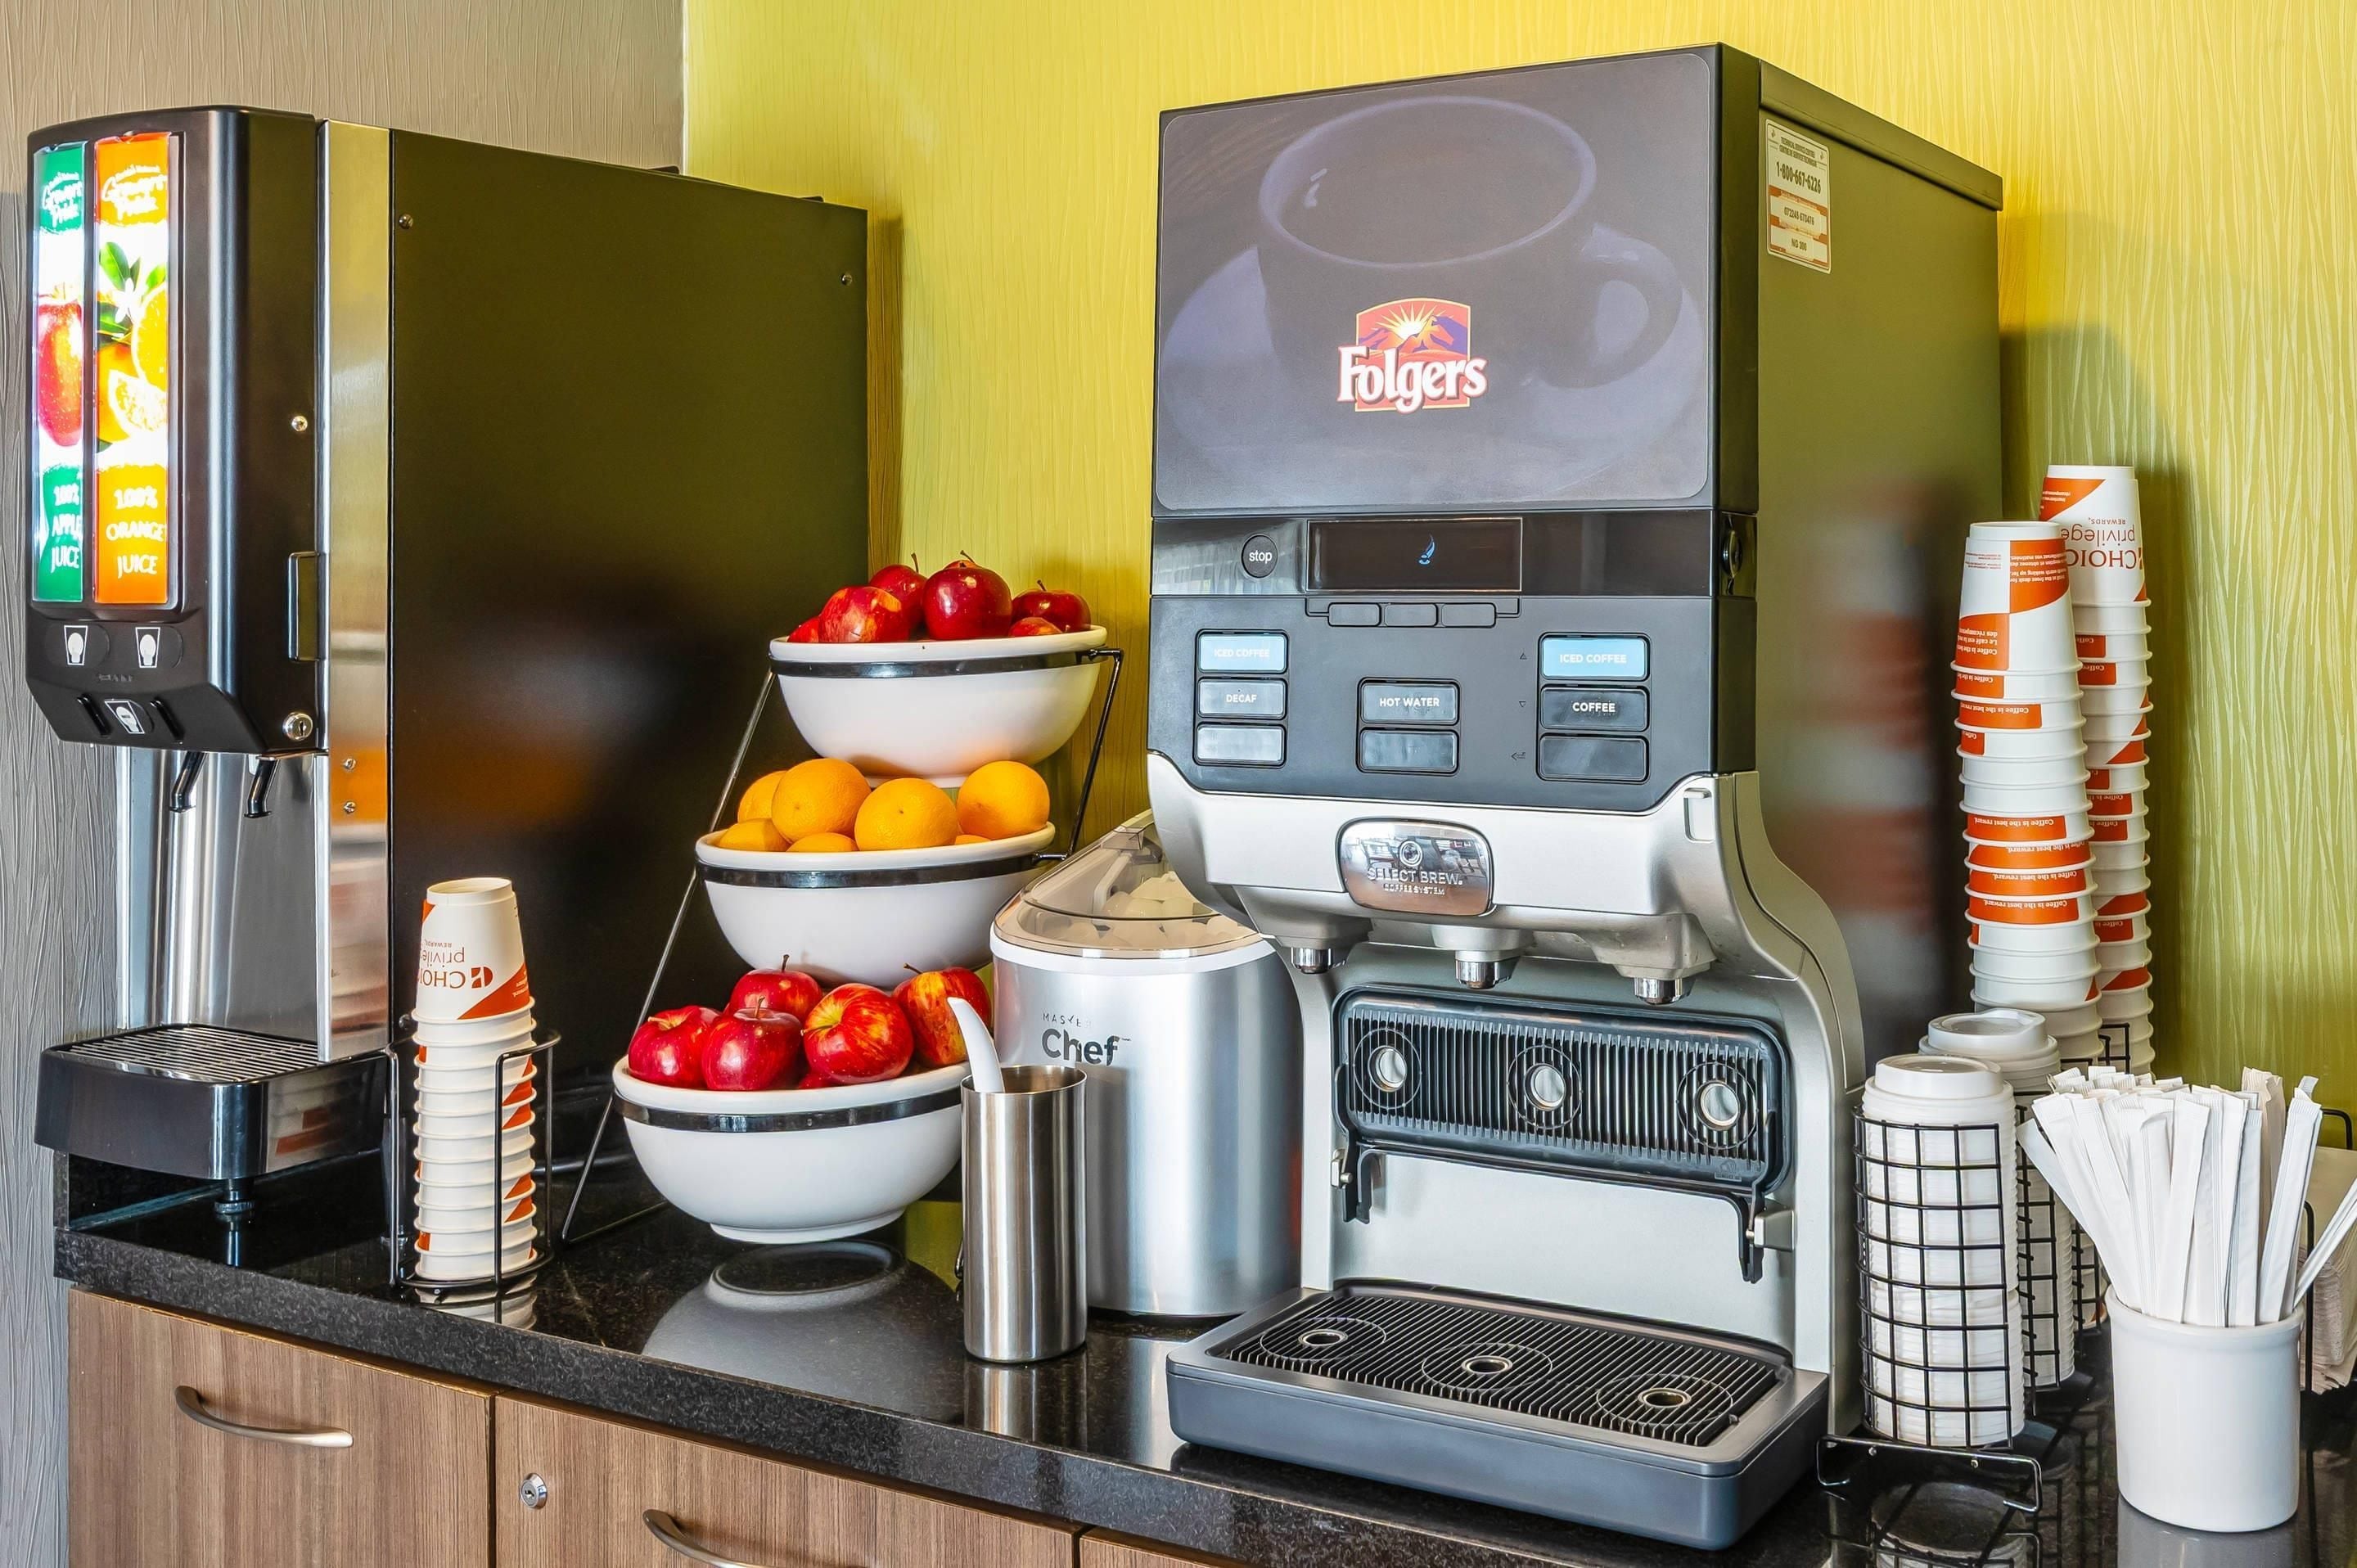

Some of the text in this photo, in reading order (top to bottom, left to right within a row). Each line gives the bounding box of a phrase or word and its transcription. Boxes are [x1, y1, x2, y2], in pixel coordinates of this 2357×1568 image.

[1776, 161, 1821, 194] 1-800-667-6226
[1336, 345, 1489, 414] Folgers
[53, 483, 80, 506] 100%
[114, 485, 158, 509] 100%
[52, 513, 83, 538] APPLE
[106, 520, 165, 542] ORANGE
[2061, 523, 2135, 547] privilege
[51, 546, 80, 574] JUICE
[1249, 550, 1272, 564] stop
[2066, 548, 2137, 570] CHOIC
[117, 554, 159, 579] JUICE
[1214, 648, 1270, 657] ICED COFFEE
[1976, 647, 1998, 656] Coffee
[1560, 654, 1627, 664] ICED COFFEE
[1974, 675, 1994, 683] Coffee
[1226, 694, 1257, 703] DECAF
[1379, 697, 1440, 707] HOT WATER
[1572, 702, 1616, 713] COFFEE
[1994, 819, 2008, 827] best
[2030, 818, 2054, 827] Coffee
[1367, 867, 1417, 881] SELECT
[2057, 871, 2077, 879] Coffee
[1383, 884, 1445, 895] COFFEE SYSTEM
[2045, 899, 2067, 908] Coffee
[422, 947, 465, 968] privile
[418, 968, 466, 989] CHOI
[1042, 1028, 1120, 1066] Chef
